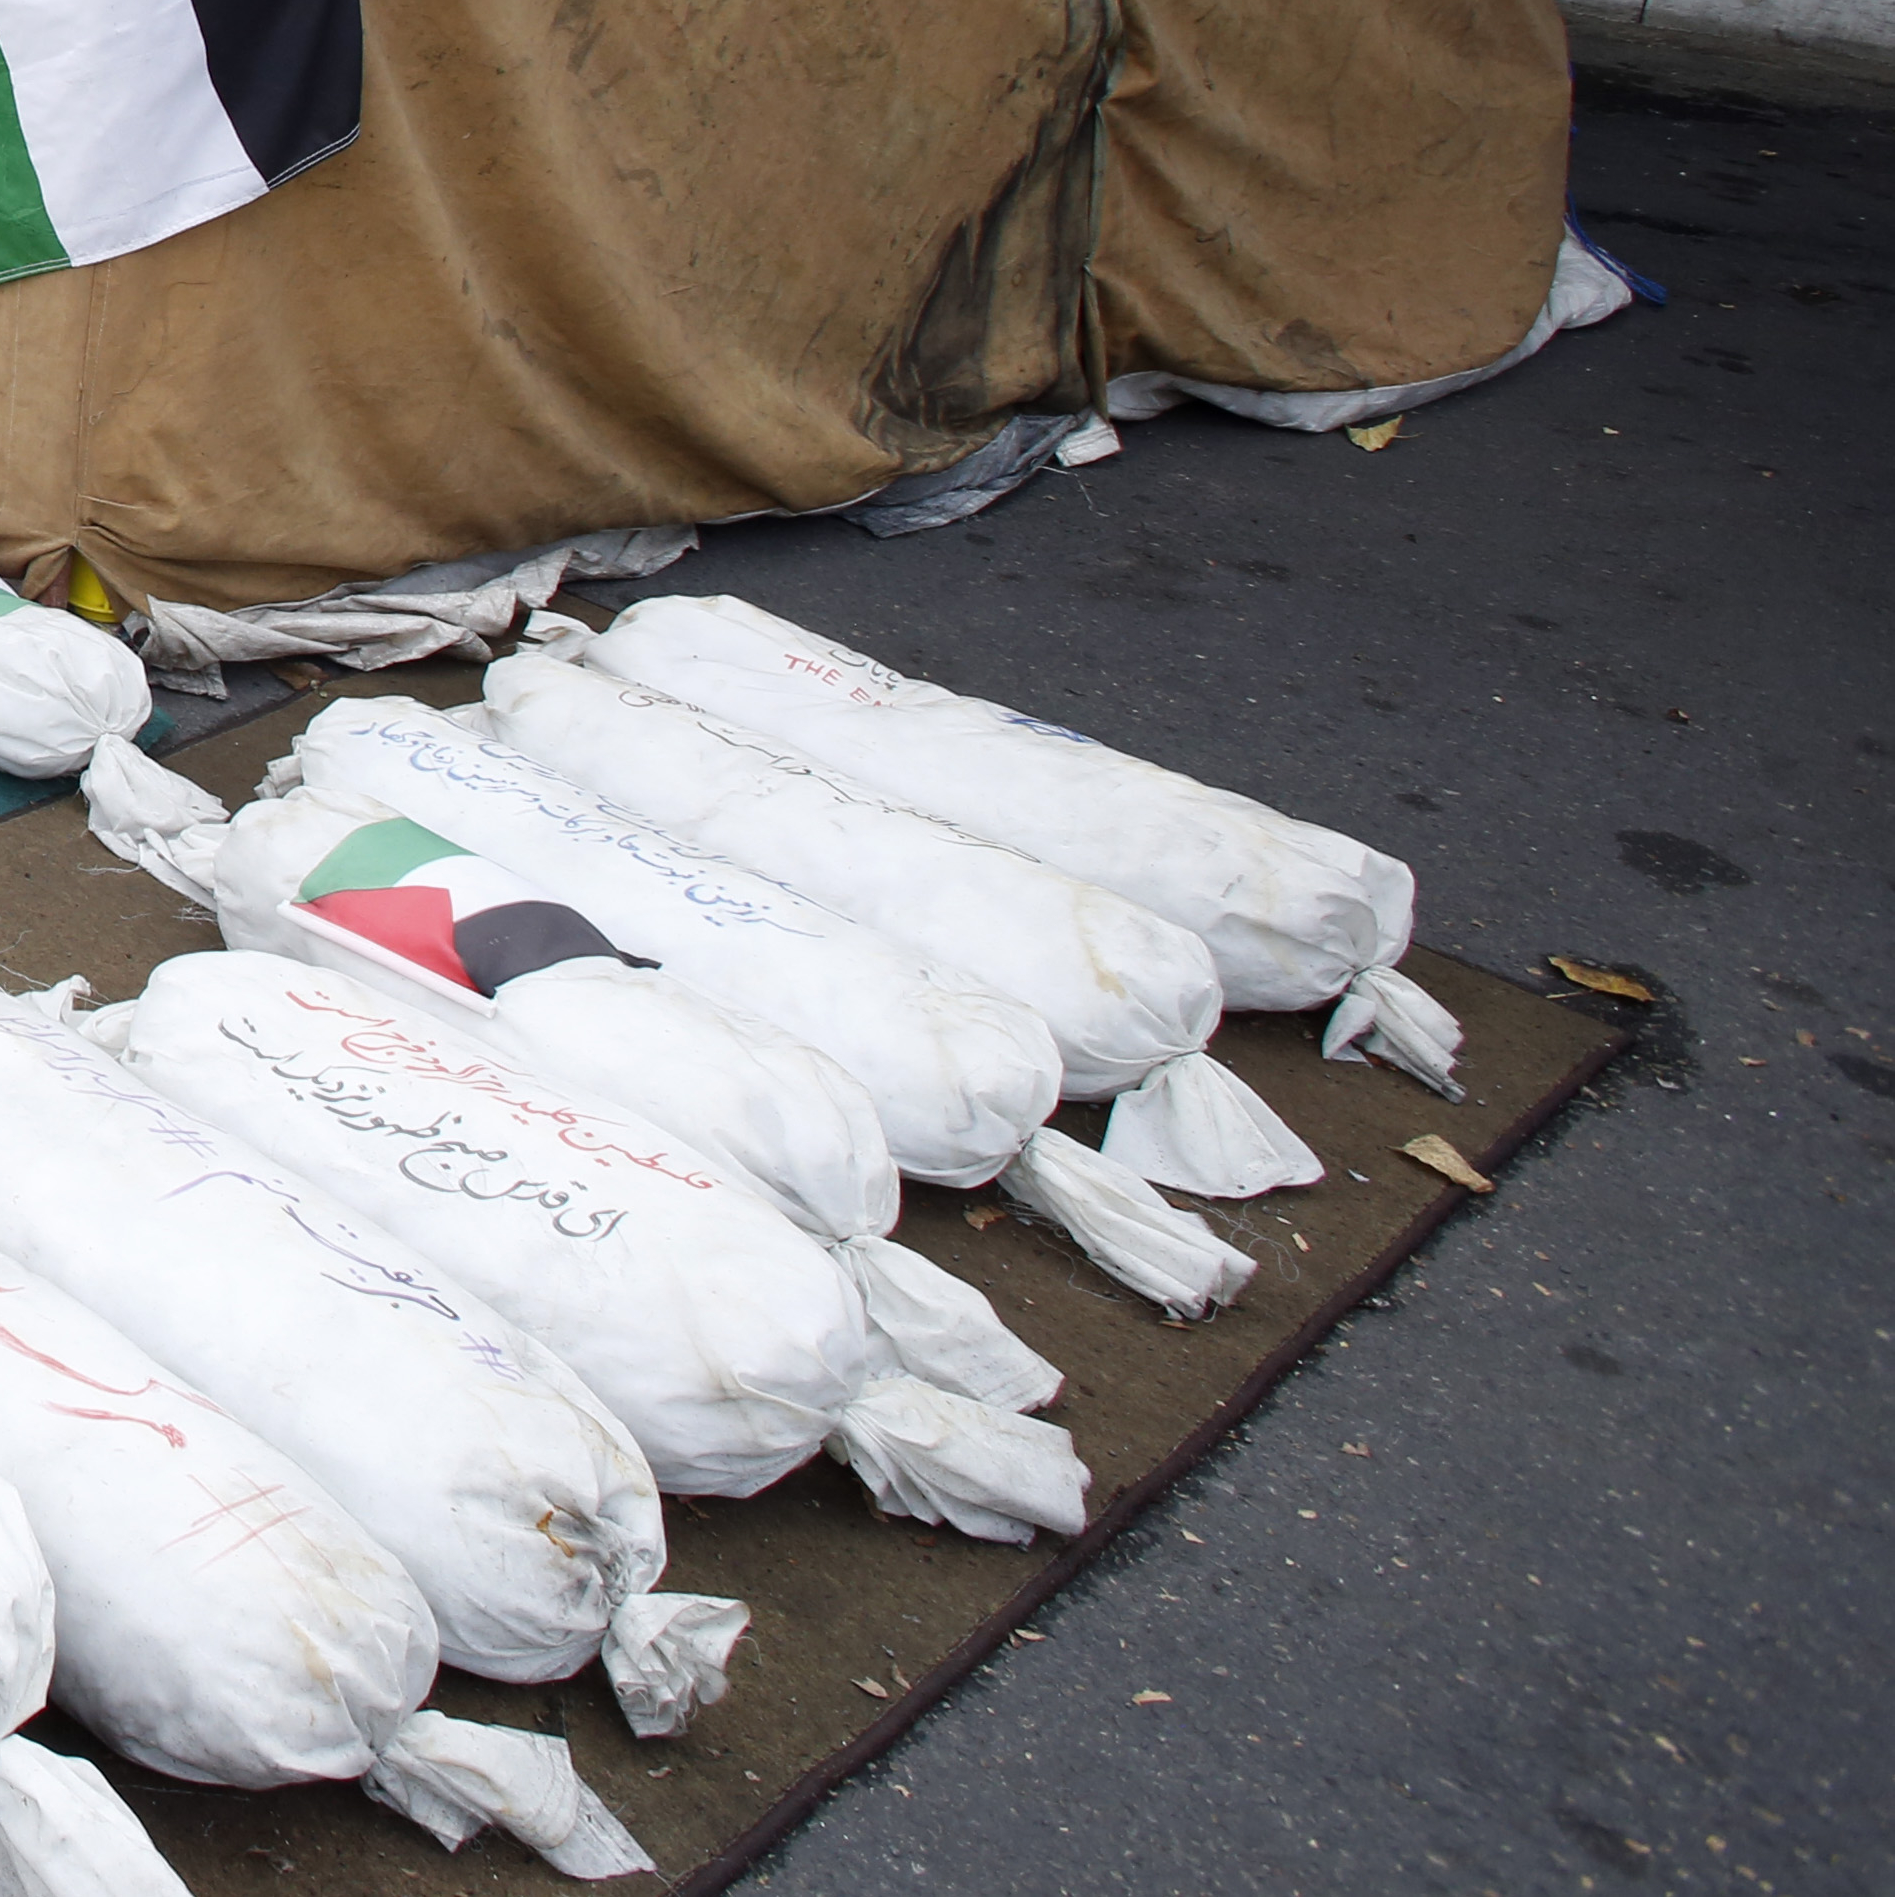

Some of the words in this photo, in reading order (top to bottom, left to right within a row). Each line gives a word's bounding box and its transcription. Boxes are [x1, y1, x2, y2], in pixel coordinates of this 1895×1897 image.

[784, 653, 844, 687] THE
[217, 1017, 305, 1063] است
[398, 1139, 509, 1193] صبح
[558, 1126, 724, 1190] فلسطین
[552, 1207, 629, 1242] ای
